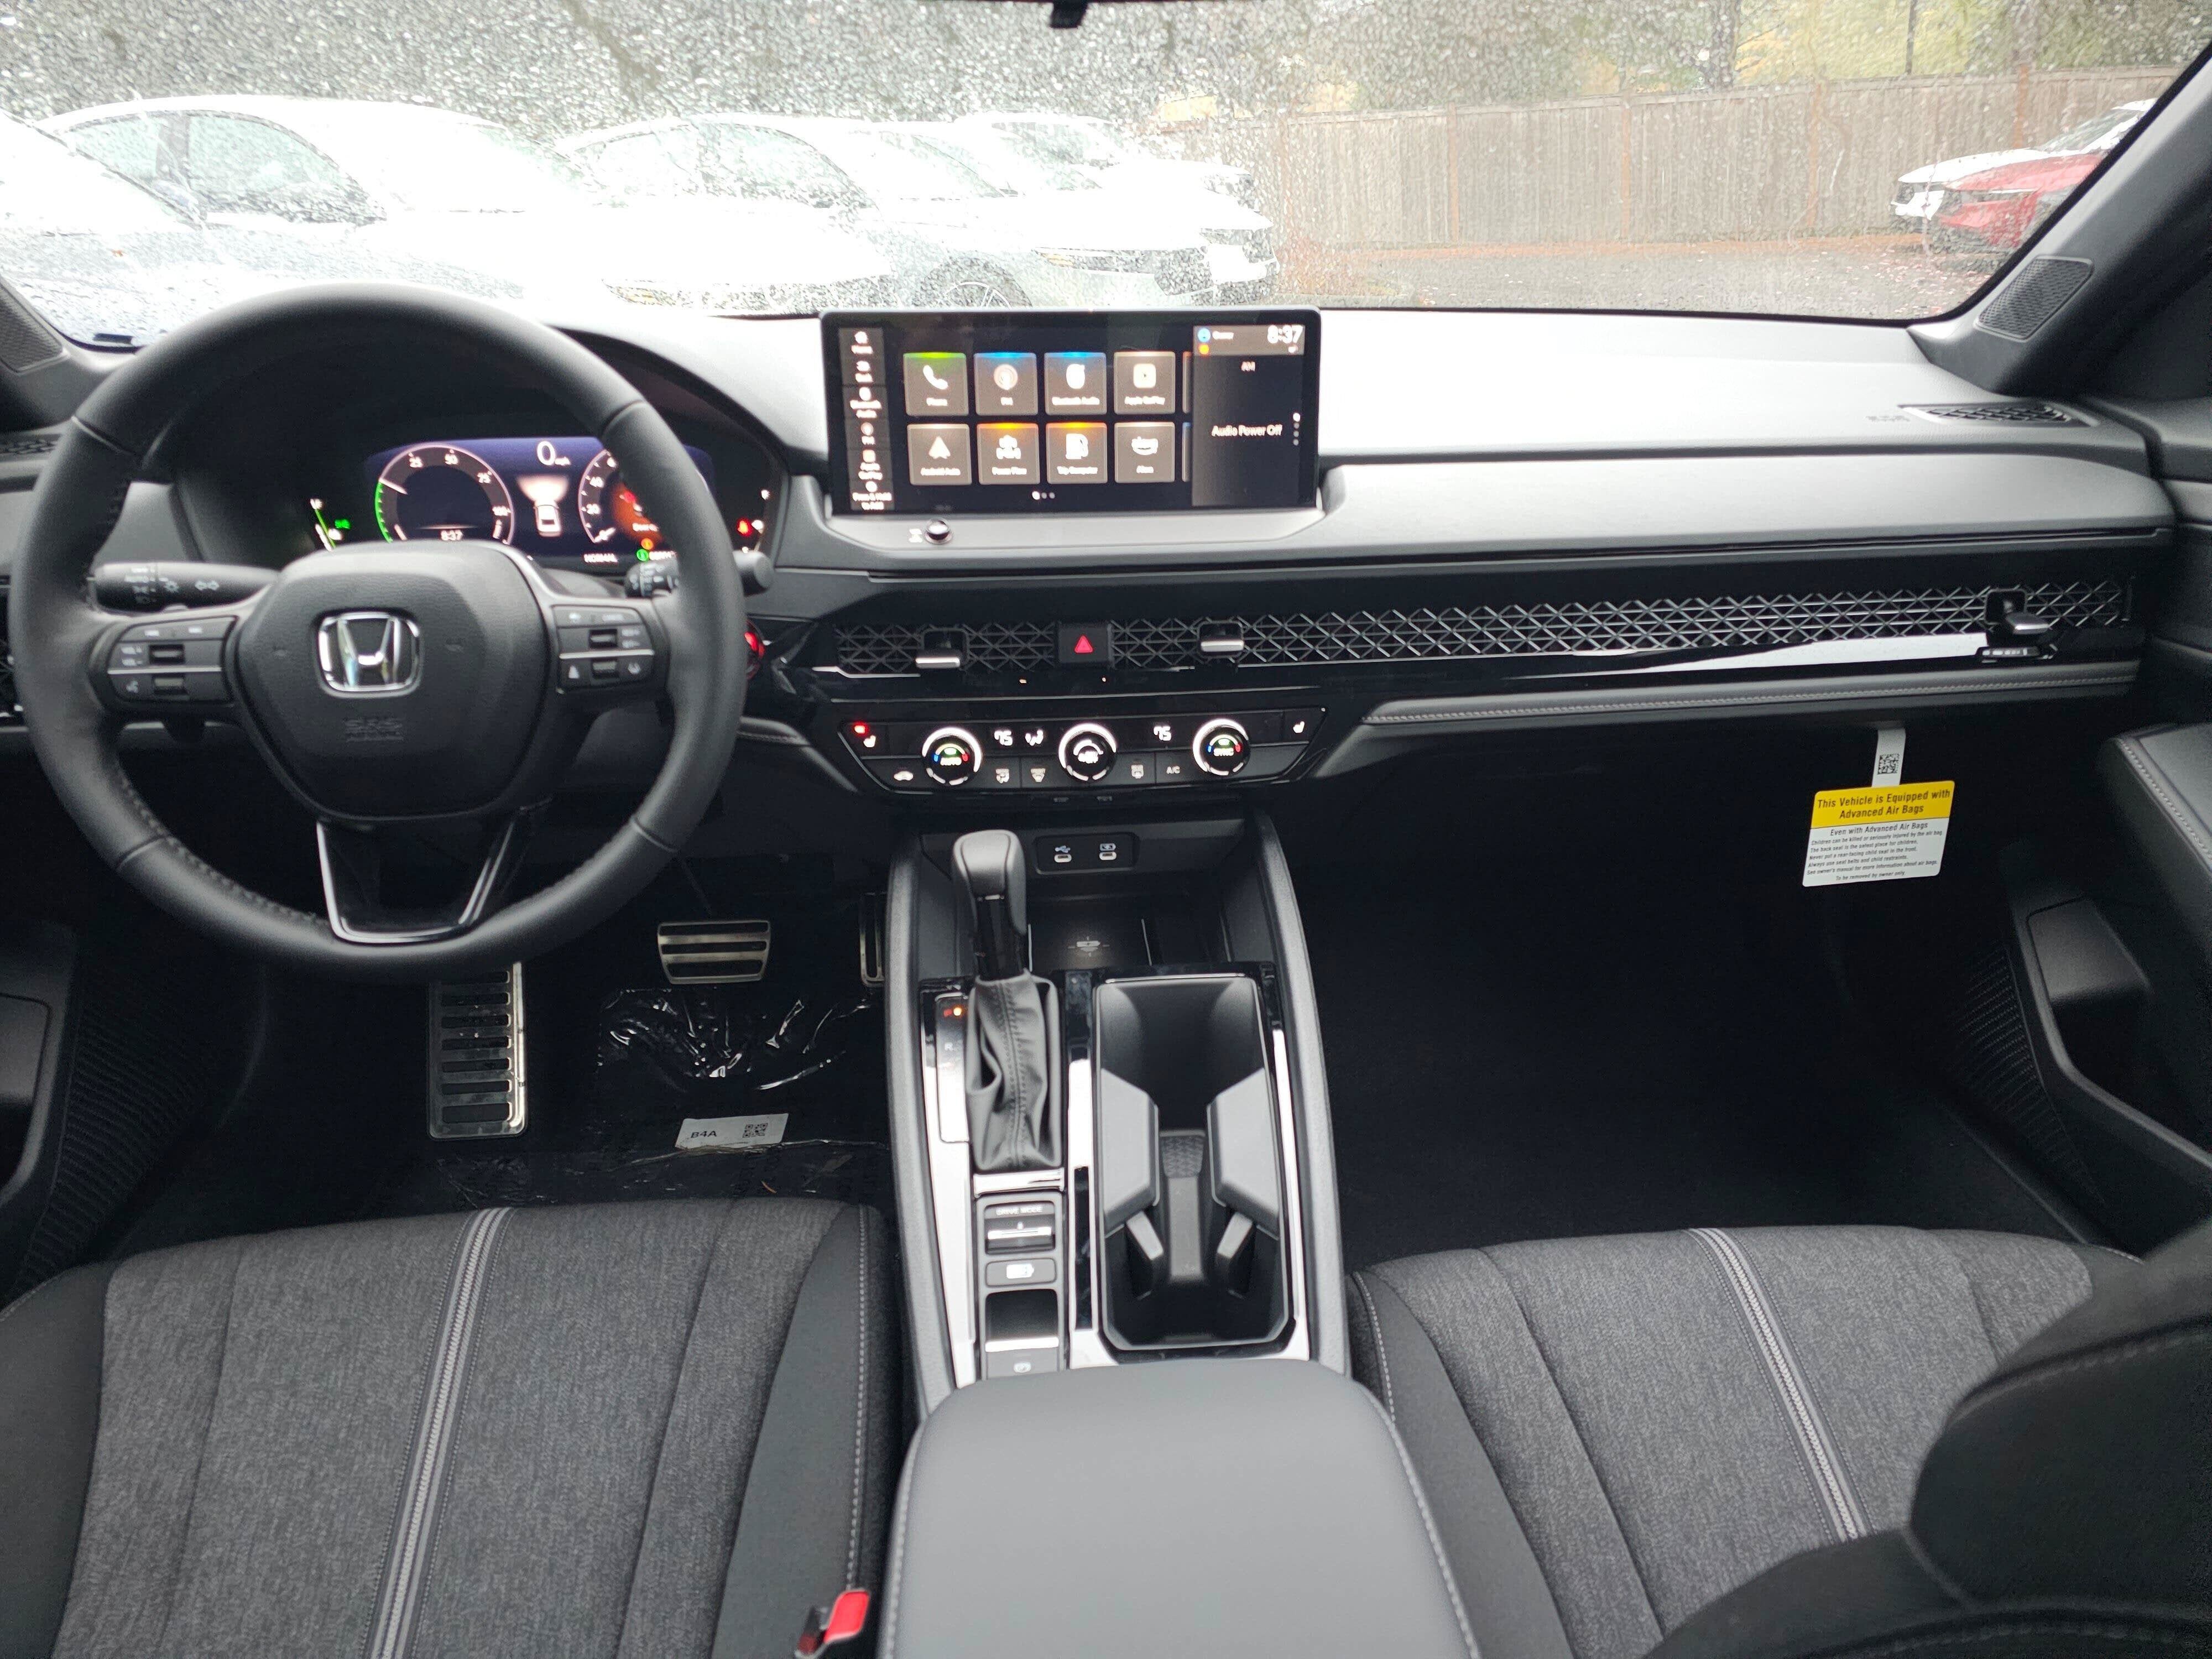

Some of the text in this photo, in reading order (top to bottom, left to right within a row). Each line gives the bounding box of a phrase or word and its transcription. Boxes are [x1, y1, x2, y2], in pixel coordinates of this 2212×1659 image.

[1267, 325, 1303, 343] 8:37
[1212, 424, 1282, 436] Audio Power Off
[537, 441, 556, 466] 0
[1166, 765, 1180, 774] A/C
[1818, 789, 1950, 808] This Vehicle is Equipped with
[1839, 805, 1924, 819] Advanced Air Bags
[1865, 823, 1897, 833] Advanced
